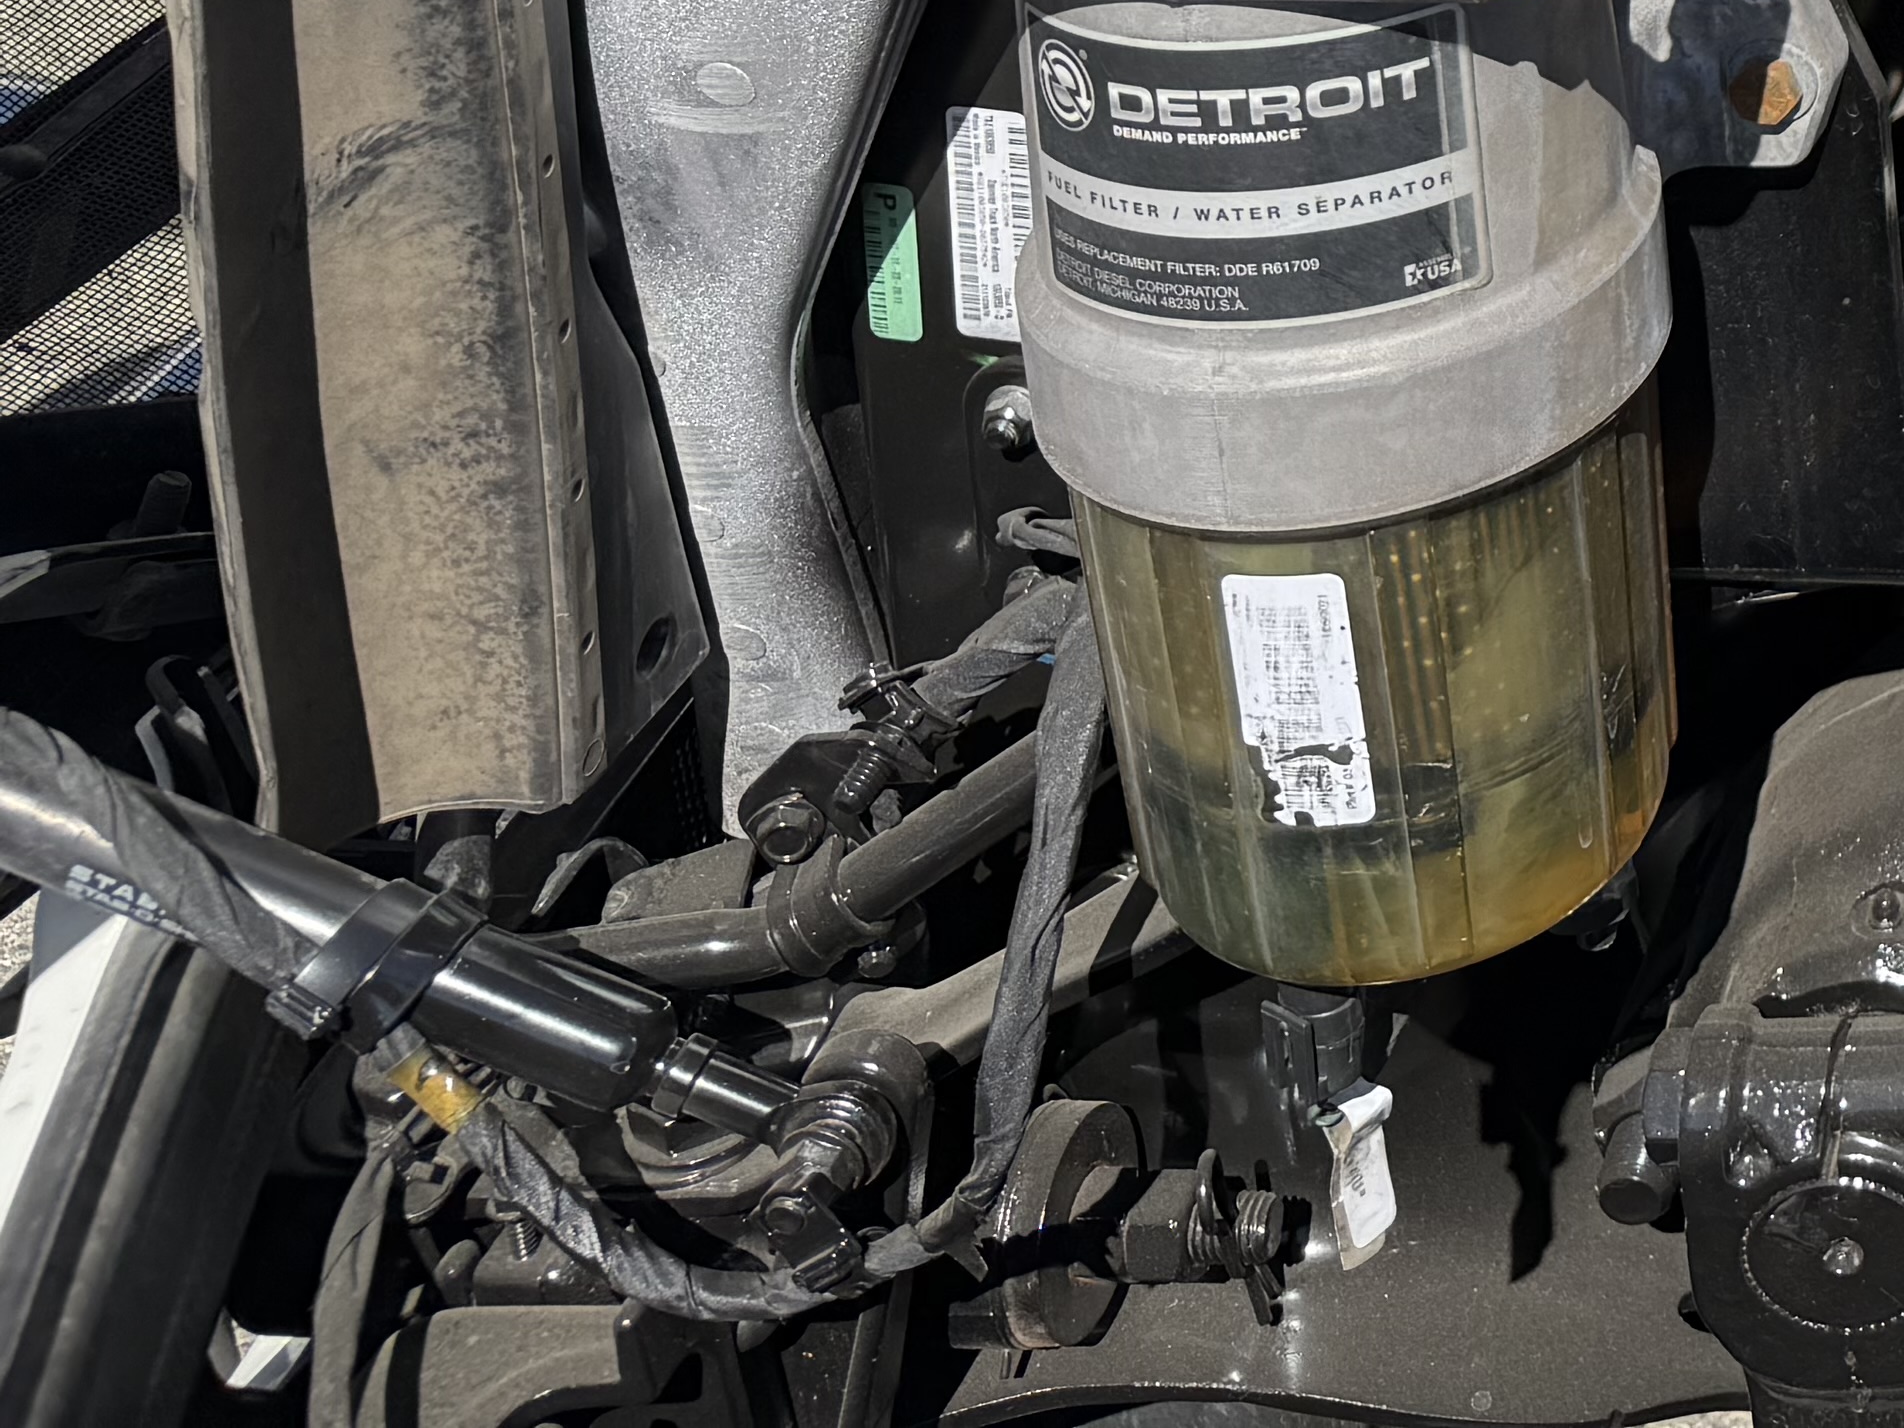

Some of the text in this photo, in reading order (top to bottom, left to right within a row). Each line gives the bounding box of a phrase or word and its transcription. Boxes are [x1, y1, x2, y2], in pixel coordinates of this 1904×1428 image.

[1107, 57, 1431, 128] DETROIT
[1113, 125, 1173, 145] DEMAND
[873, 192, 898, 212] P
[1047, 169, 1454, 222] FUEL FILTER / WATER SEPARATOR
[1054, 226, 1320, 277] USES REPLACEMENT FILTER: DDE R61709
[1056, 246, 1240, 299] DETROIT DIESEL CORPORATION
[1426, 258, 1462, 280] USA
[1097, 279, 1157, 307] MICHIGAN
[1161, 296, 1201, 311] 48239
[1204, 298, 1249, 312] U.S.A.
